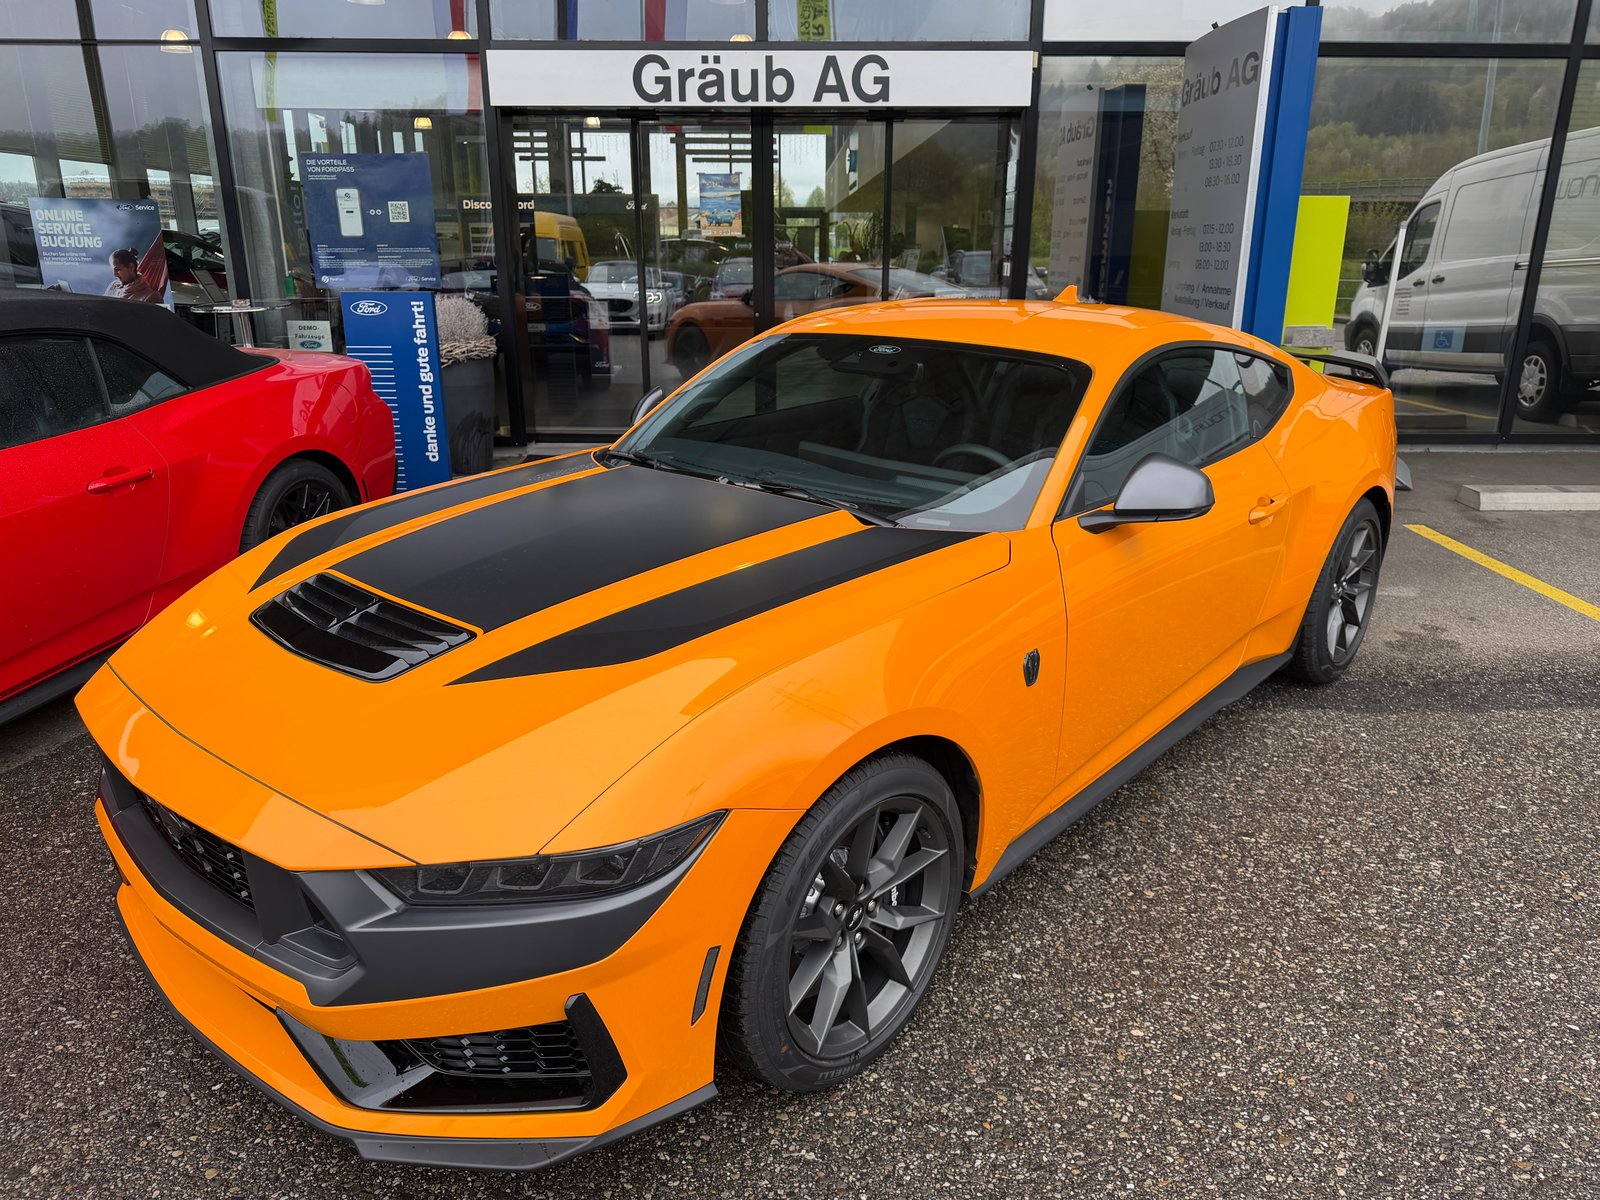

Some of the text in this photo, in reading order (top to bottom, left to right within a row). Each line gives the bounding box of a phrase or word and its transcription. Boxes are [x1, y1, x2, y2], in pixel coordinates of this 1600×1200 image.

[632, 53, 891, 103] Gräub AG
[1181, 51, 1260, 107] Gräub AG
[463, 200, 535, 209] Disco ord
[36, 209, 84, 222] ONLINE
[39, 223, 92, 235] SERVICE
[1219, 223, 1235, 234] 12.00
[42, 235, 103, 248] BUCHUNG
[1202, 283, 1232, 296] Annahme
[356, 302, 382, 314] Ford
[1205, 298, 1230, 311] Verkauf
[411, 301, 439, 463] danke und gute fahrt!
